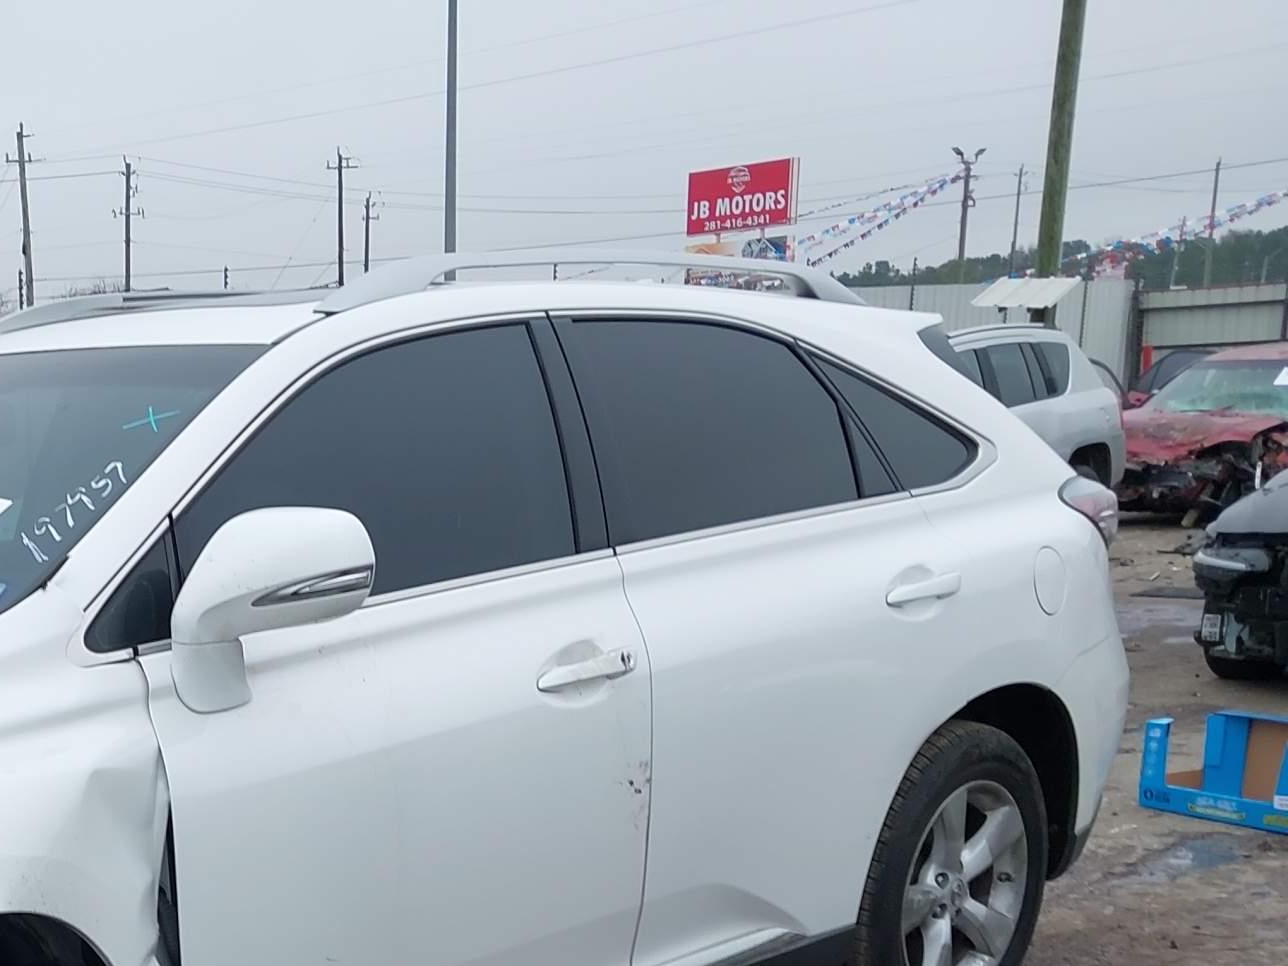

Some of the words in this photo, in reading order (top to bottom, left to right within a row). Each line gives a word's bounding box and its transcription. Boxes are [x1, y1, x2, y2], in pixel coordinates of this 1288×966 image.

[691, 200, 710, 220] JB
[715, 189, 786, 217] MOTORS
[703, 214, 770, 231] 281-416-4341
